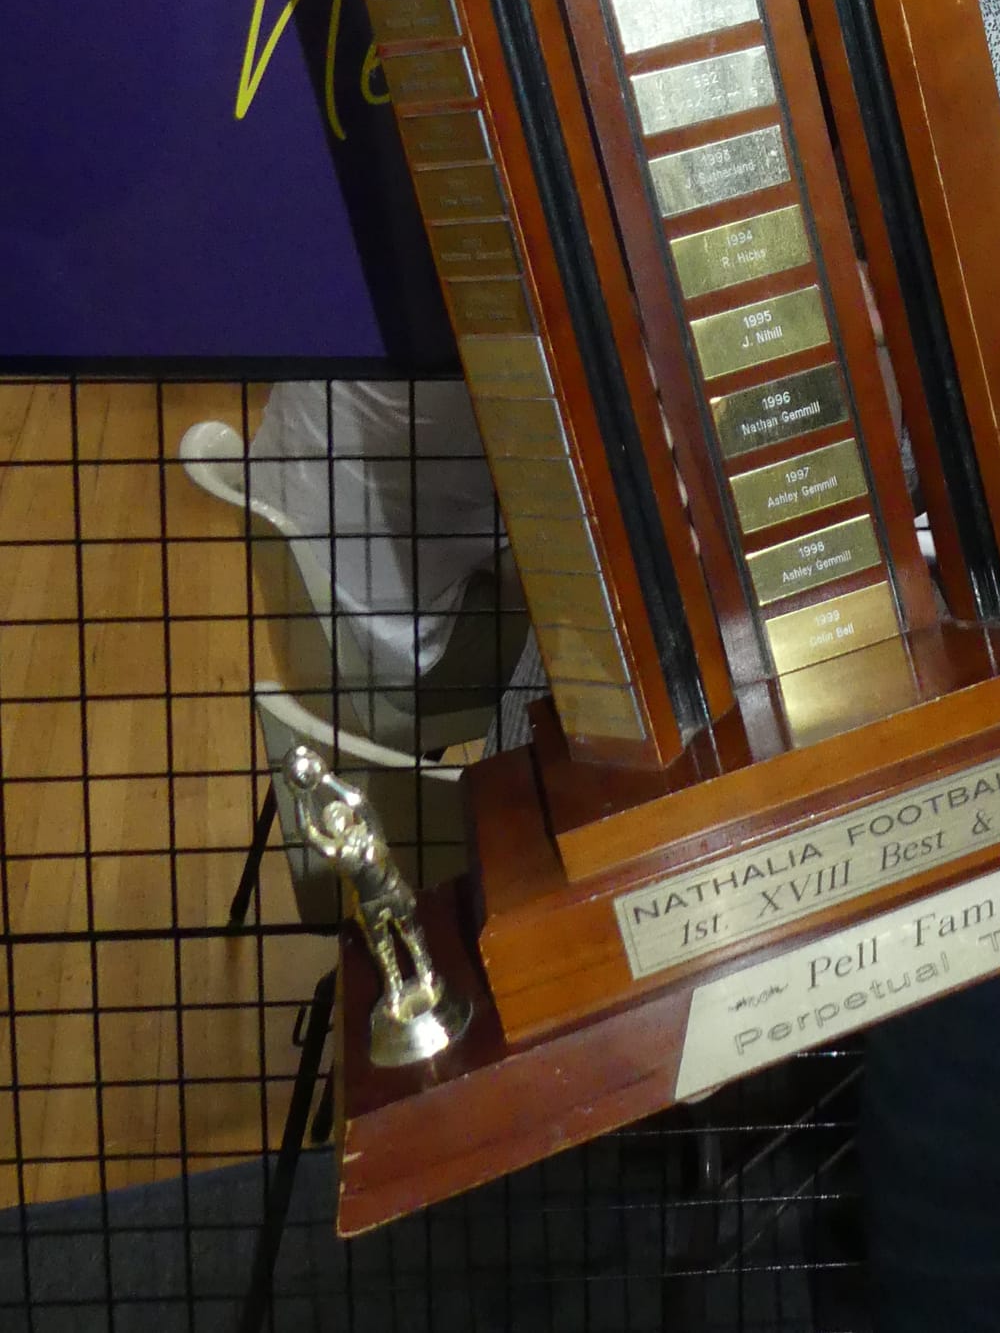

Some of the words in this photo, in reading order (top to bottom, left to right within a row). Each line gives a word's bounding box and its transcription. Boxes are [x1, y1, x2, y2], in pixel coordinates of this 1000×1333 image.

[726, 230, 753, 248] 1994
[743, 310, 772, 329] 1995
[742, 335, 753, 349] J.
[755, 325, 783, 344] Nihill
[762, 391, 791, 410] 1996
[741, 417, 778, 436] Nathan
[781, 400, 821, 423] Gemmill
[785, 466, 810, 484] 1997
[767, 489, 798, 509] Ashley
[801, 475, 838, 497] Gemmill
[798, 541, 825, 558] 1998
[781, 564, 813, 583] Ashley
[815, 550, 852, 571] Gemmill
[815, 609, 841, 627] 1999
[835, 623, 855, 639] Bell
[758, 858, 854, 917] XVIII
[881, 829, 946, 871] Best
[971, 810, 994, 836] &
[632, 842, 823, 924] NATHALIA
[805, 935, 880, 992] Pell
[733, 952, 952, 1056] Perpetual
